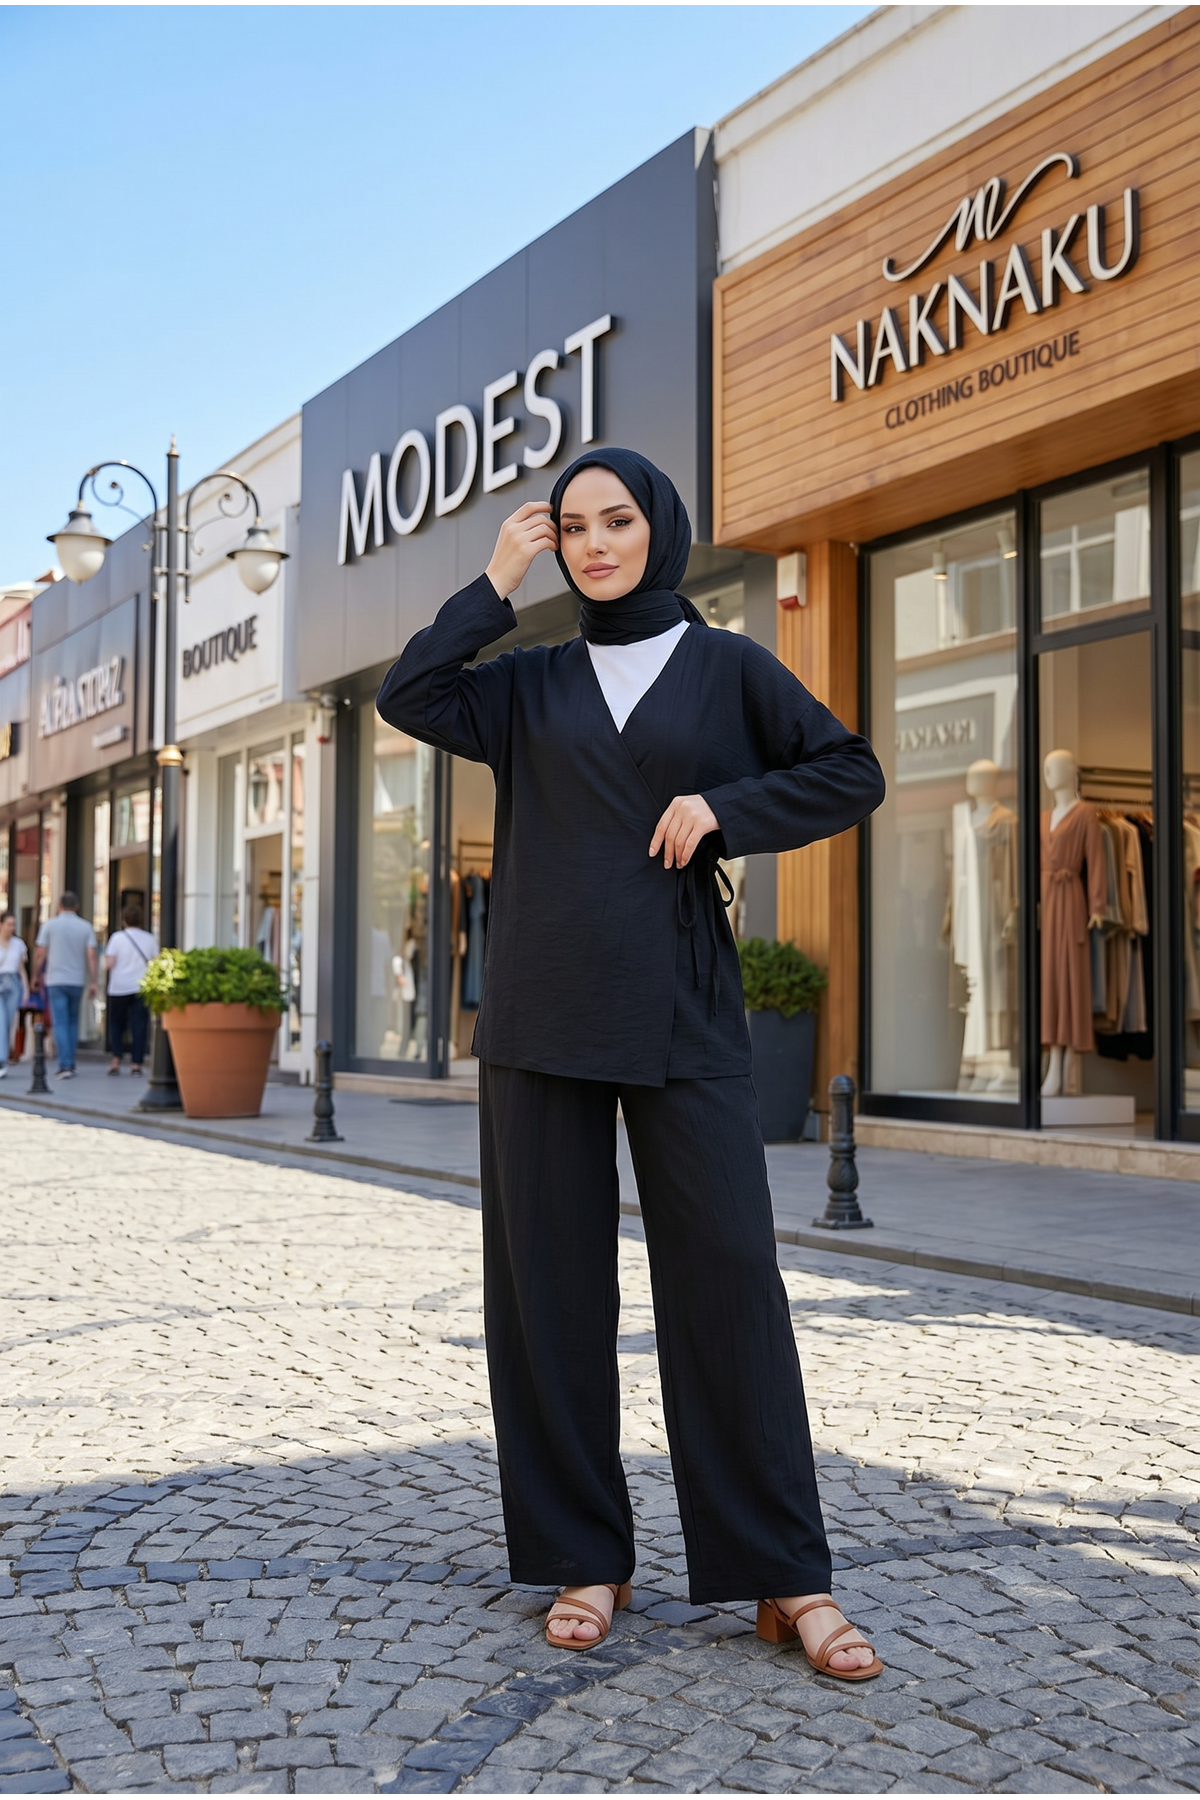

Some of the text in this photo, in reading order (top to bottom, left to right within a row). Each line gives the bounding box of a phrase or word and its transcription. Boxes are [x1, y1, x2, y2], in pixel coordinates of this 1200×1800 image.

[830, 187, 1135, 402] NAKNAKU
[337, 313, 612, 566] MODEST
[885, 330, 1081, 429] CLOTHING BOUTIQUE
[182, 614, 257, 679] BOUTIQUE
